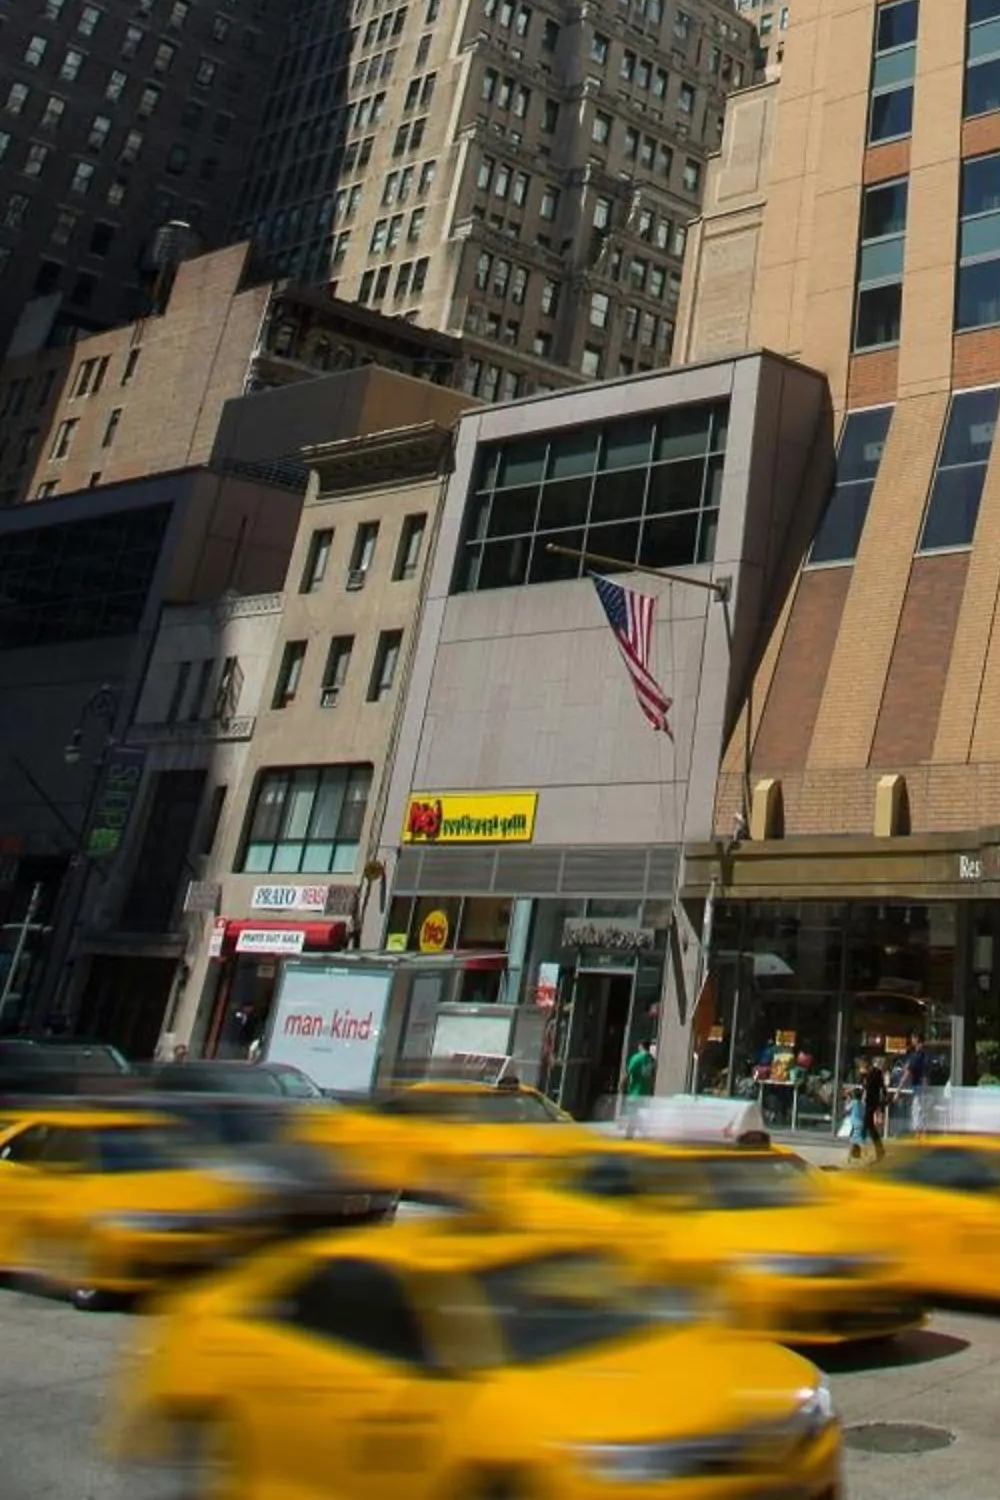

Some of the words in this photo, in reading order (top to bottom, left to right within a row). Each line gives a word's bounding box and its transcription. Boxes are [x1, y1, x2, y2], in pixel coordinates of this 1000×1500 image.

[959, 855, 982, 878] Res
[255, 887, 297, 905] PRATO
[285, 1014, 323, 1037] man
[331, 1008, 373, 1040] kind
